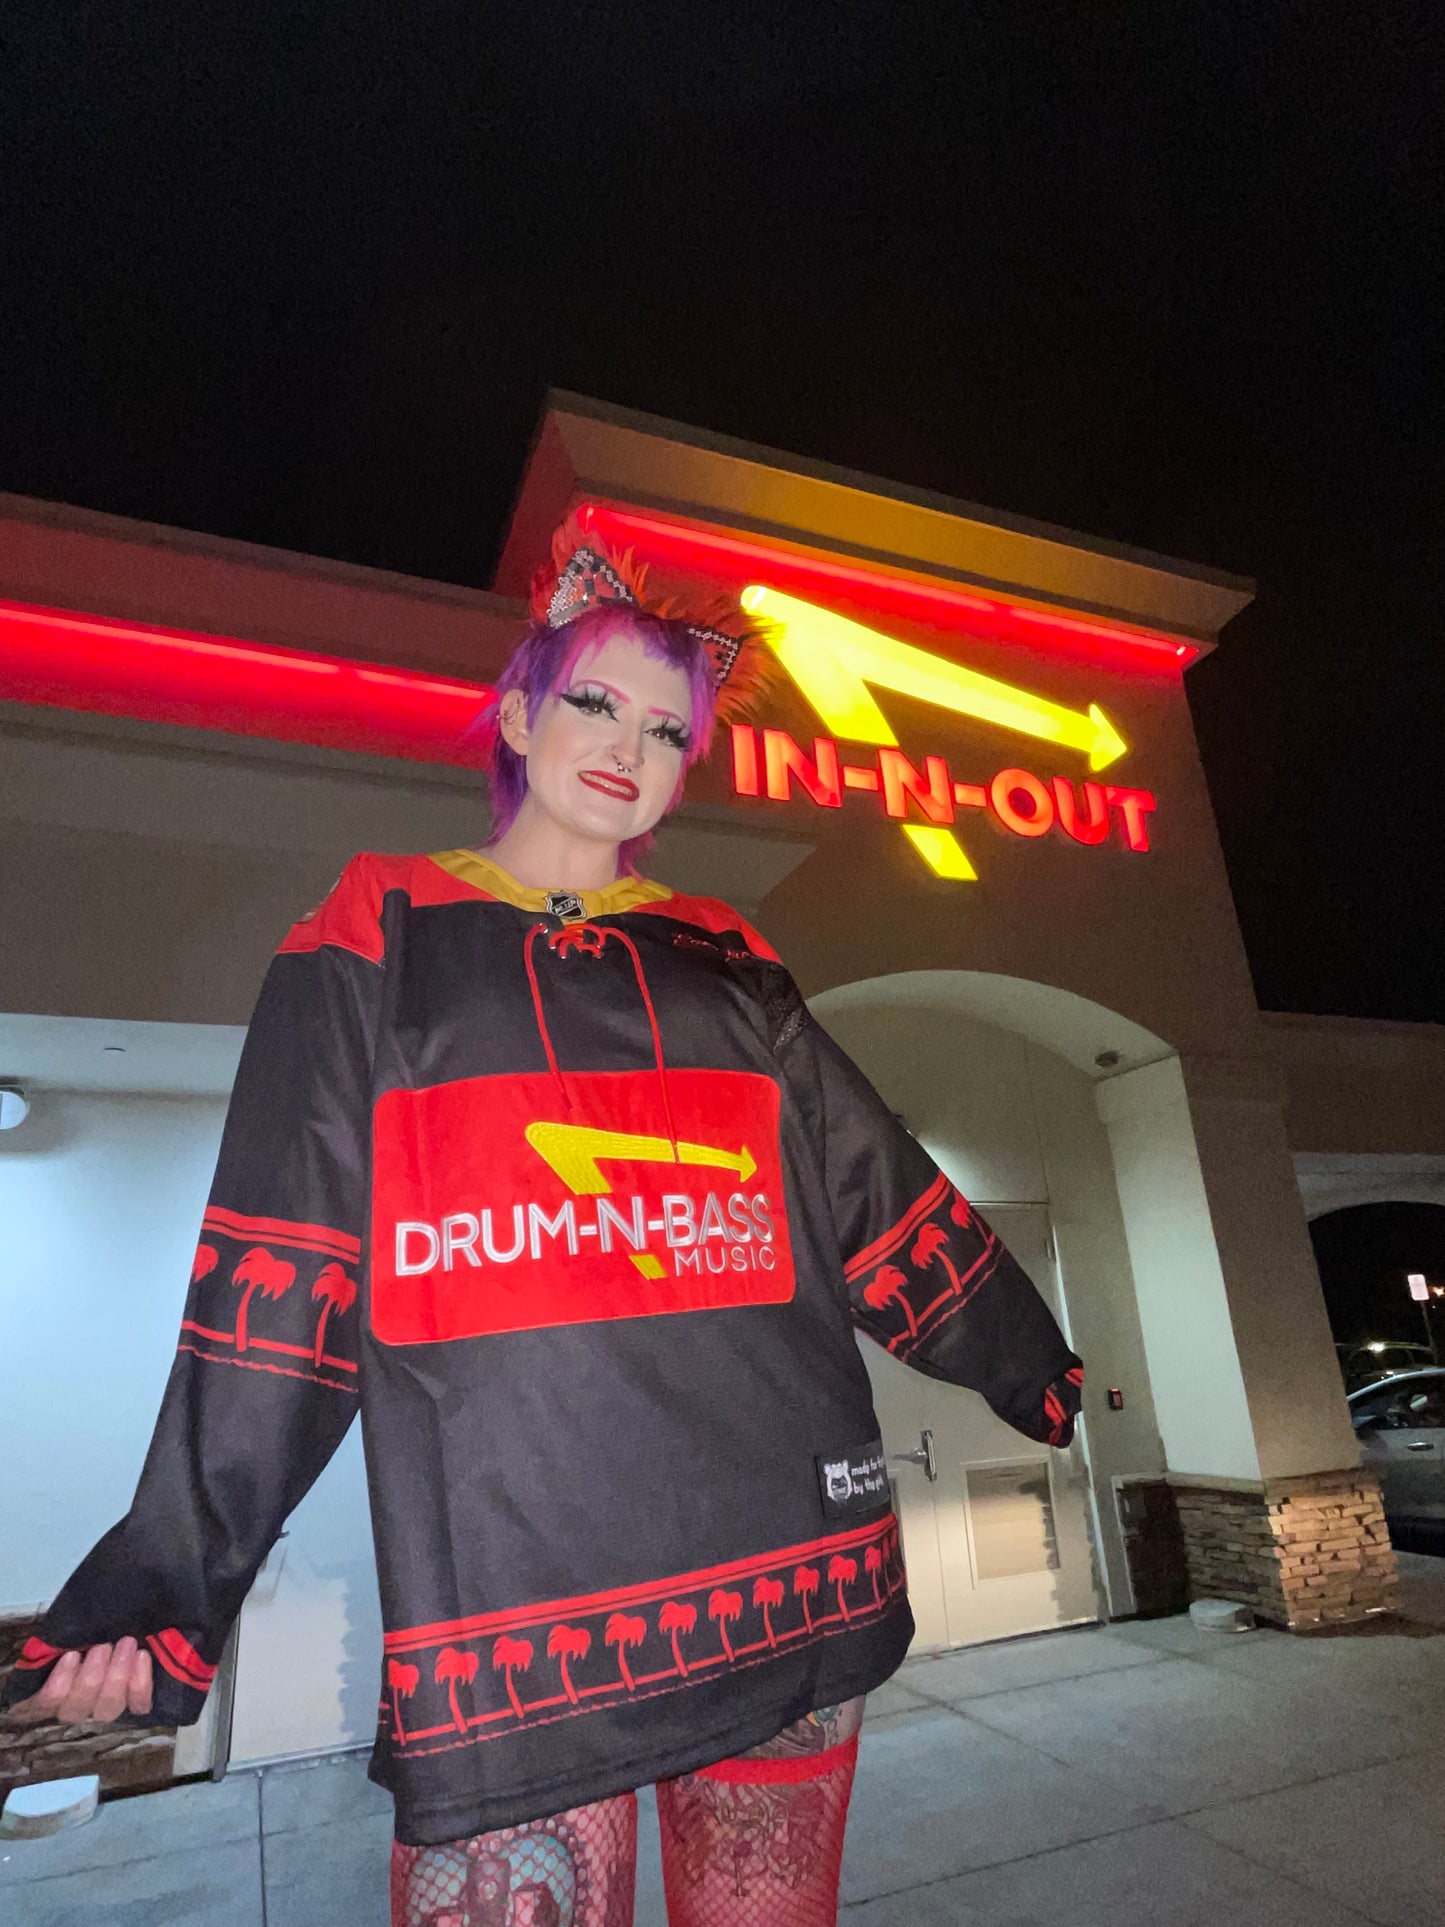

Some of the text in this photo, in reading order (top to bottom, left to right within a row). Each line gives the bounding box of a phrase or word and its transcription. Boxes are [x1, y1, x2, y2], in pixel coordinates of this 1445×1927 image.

[731, 724, 1157, 853] IN-N-OUT
[395, 1192, 775, 1277] DRUM-N-BASS
[674, 1246, 777, 1277] MUSIC
